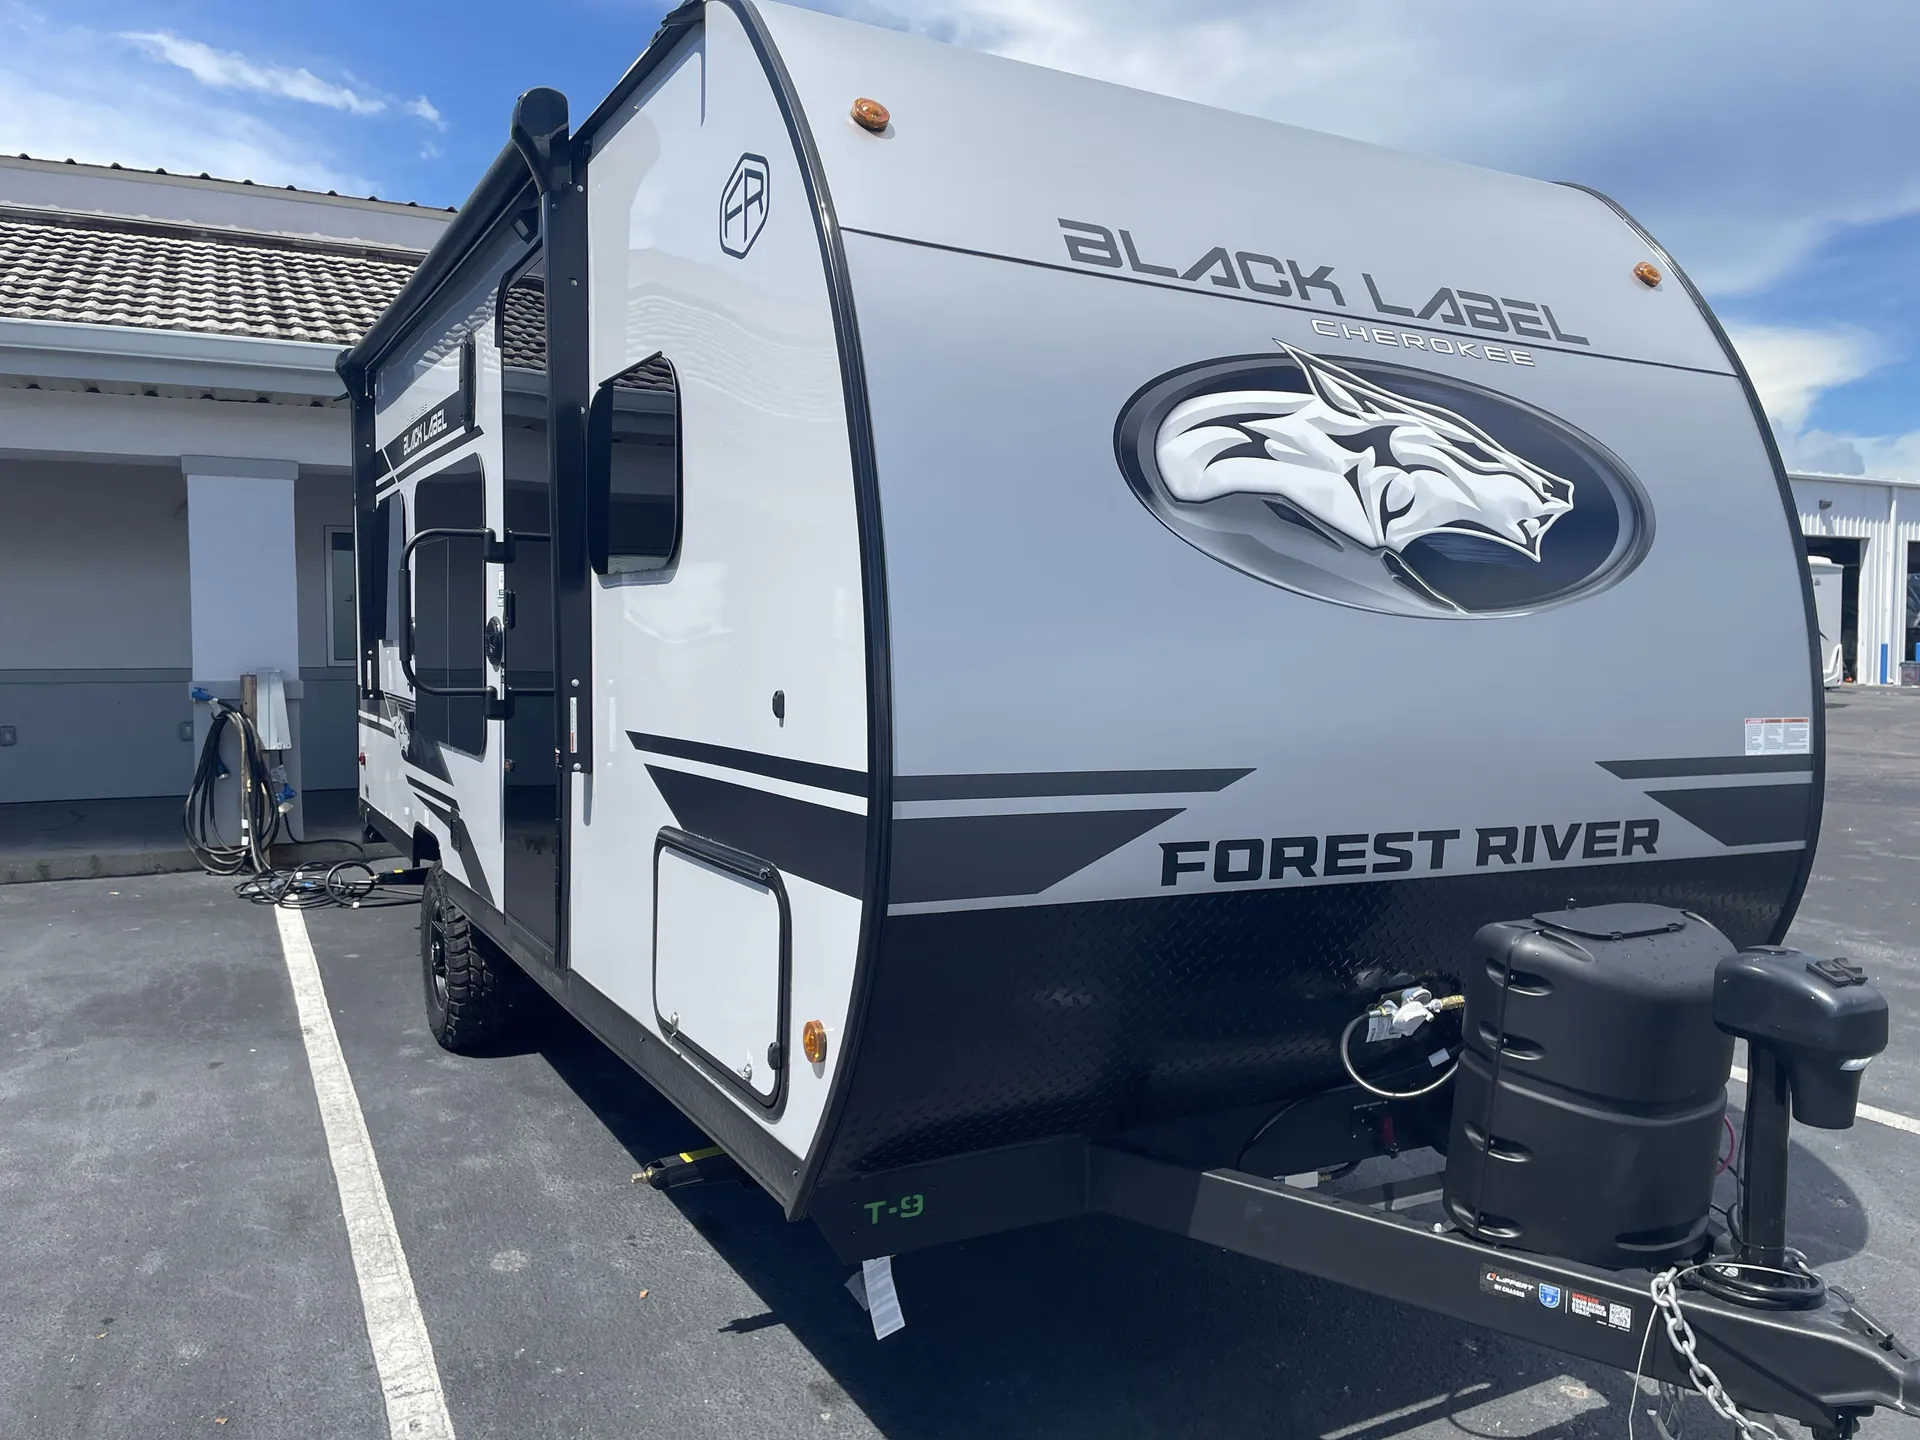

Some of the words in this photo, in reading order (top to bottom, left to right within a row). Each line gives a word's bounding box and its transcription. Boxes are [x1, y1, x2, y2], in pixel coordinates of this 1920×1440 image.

[1057, 217, 1347, 307] BLACK
[1361, 272, 1591, 347] LABEL
[1310, 318, 1537, 368] CHEROKEE
[403, 423, 423, 456] BLACK
[423, 408, 448, 442] LABEL
[1158, 829, 1461, 886] FOREST
[1475, 818, 1661, 867] RIVER
[863, 1194, 924, 1225] T-9
